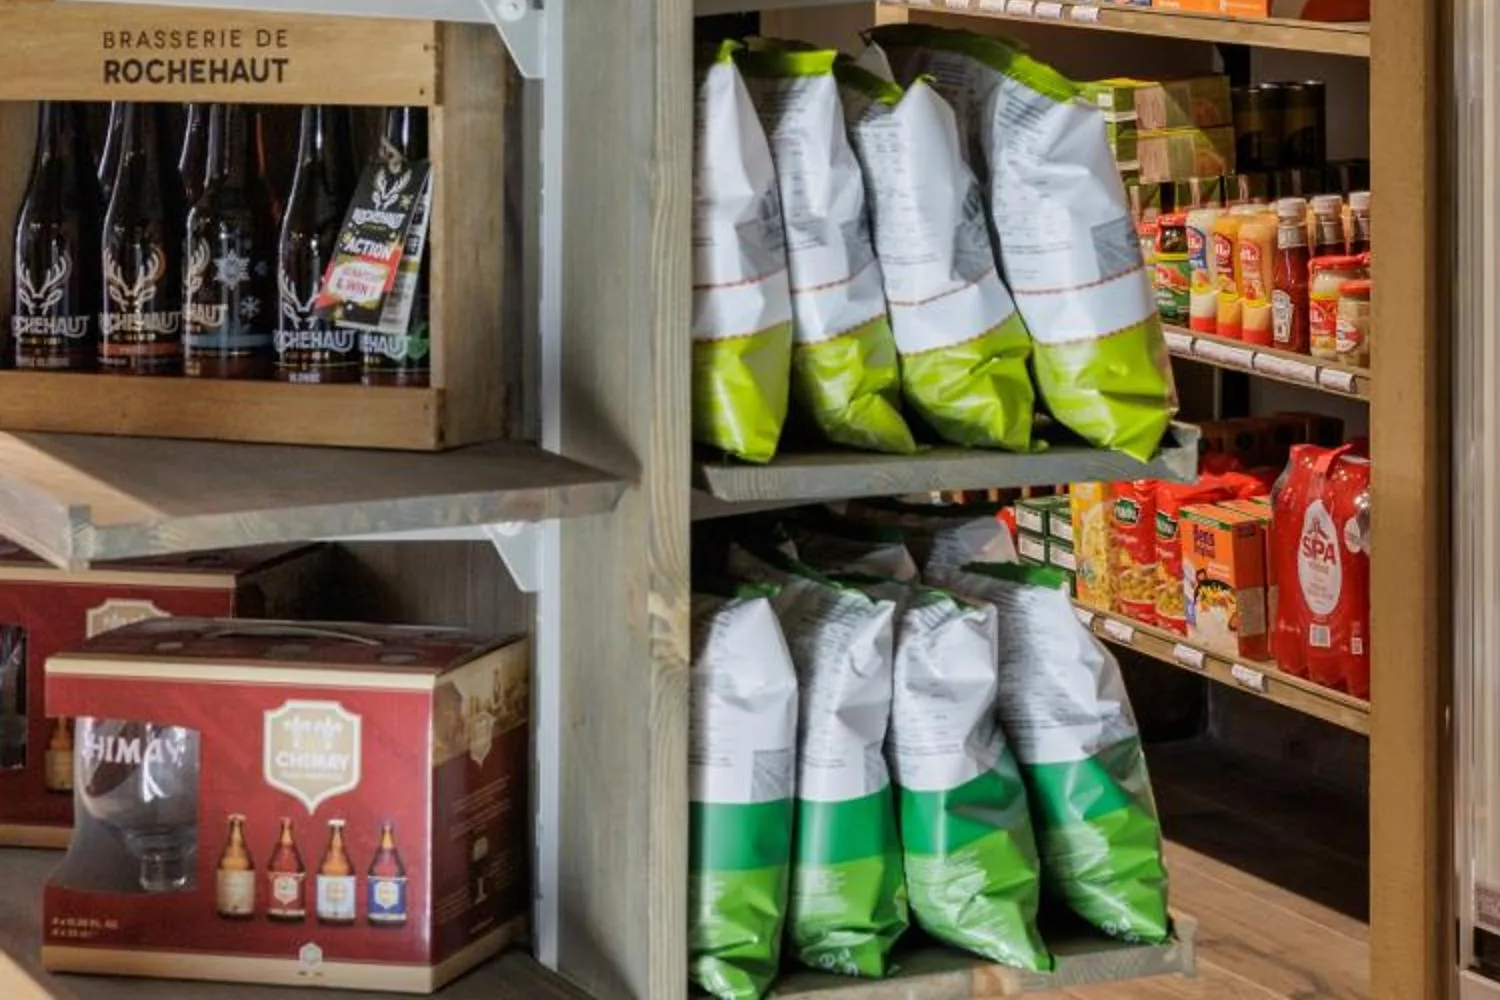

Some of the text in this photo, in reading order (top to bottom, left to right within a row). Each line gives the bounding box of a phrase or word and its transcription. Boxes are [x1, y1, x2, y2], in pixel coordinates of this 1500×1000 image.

[102, 28, 290, 51] BRASSERIE DE
[103, 57, 290, 86] ROCHEHAUT
[343, 236, 392, 261] ACTION
[1303, 536, 1337, 566] SPA
